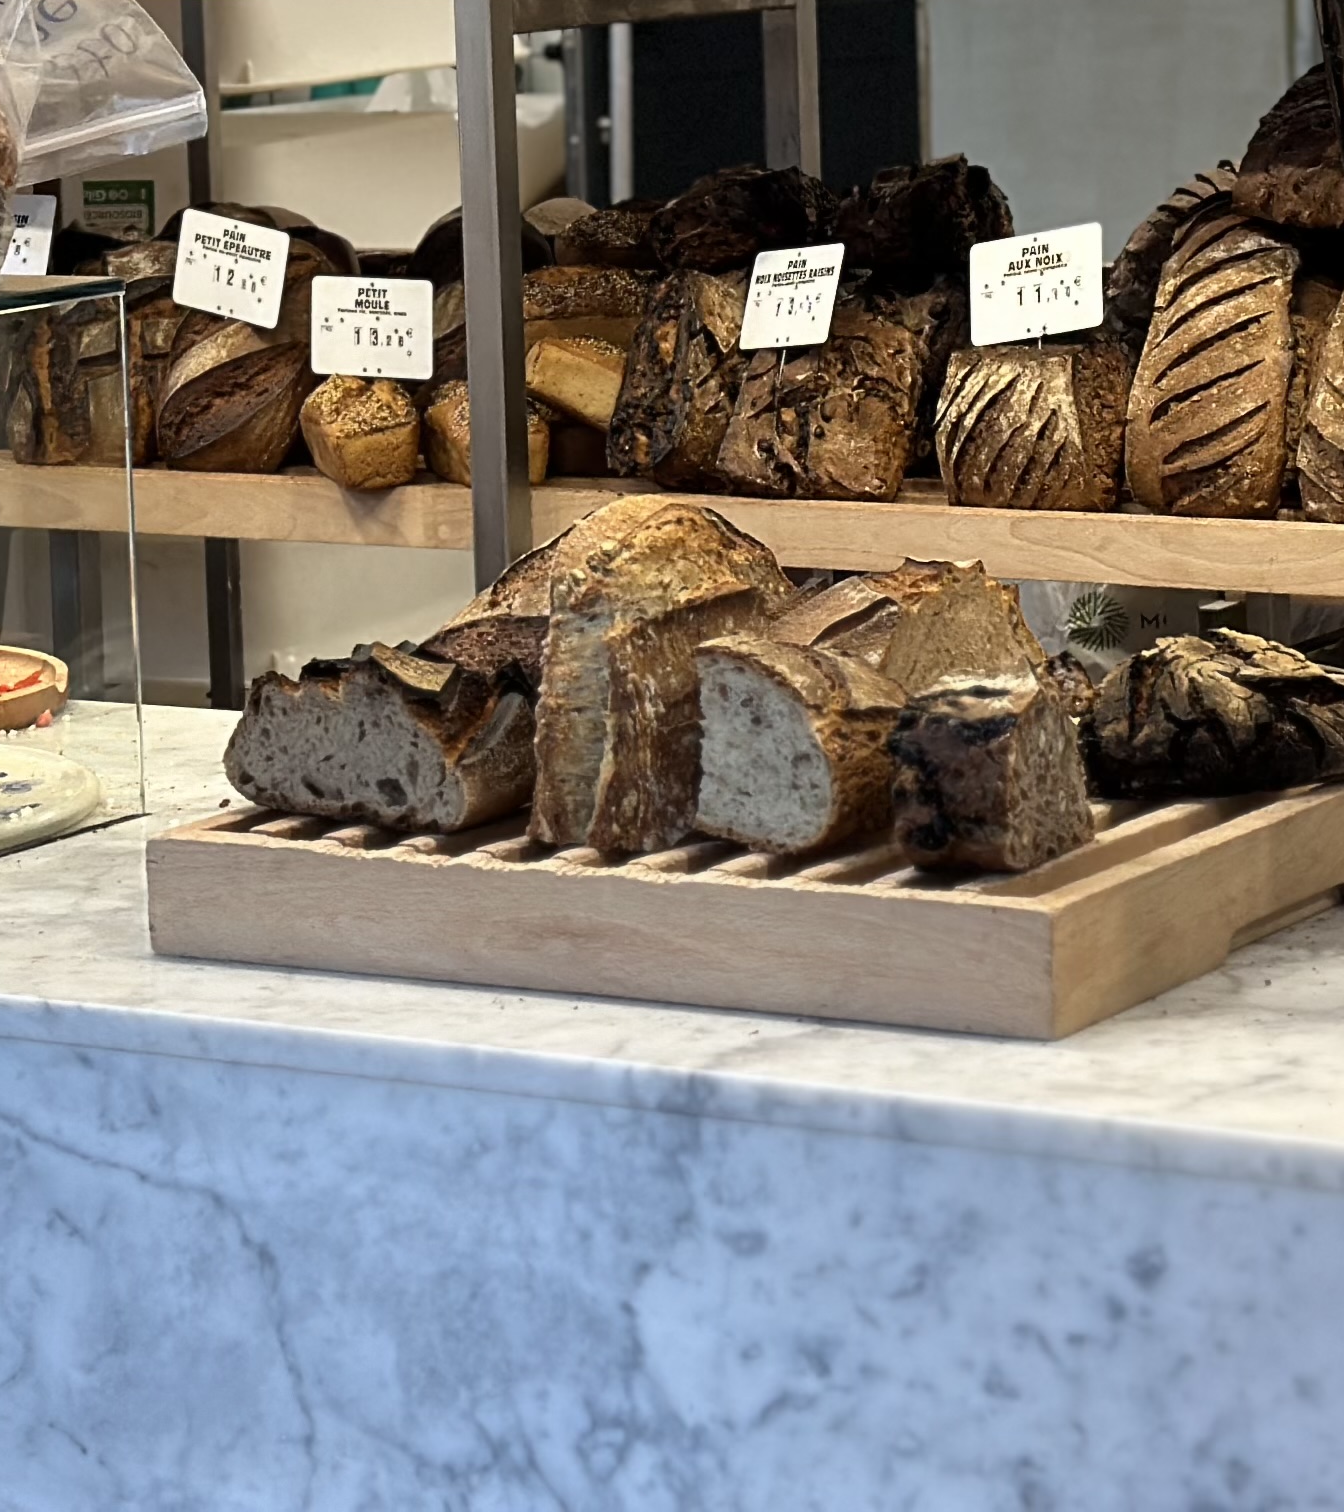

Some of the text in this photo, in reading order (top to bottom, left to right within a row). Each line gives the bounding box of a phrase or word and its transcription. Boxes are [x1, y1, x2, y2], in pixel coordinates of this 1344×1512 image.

[223, 229, 246, 243] PAIN
[195, 233, 221, 247] PETIT
[223, 240, 272, 261] EPEAUTRE
[1021, 243, 1049, 258] PAIN
[787, 259, 808, 269] PAIN
[1008, 259, 1031, 272] AUX
[1036, 252, 1063, 267] NOIX
[358, 288, 388, 298] PETIT
[354, 299, 390, 310] MOULE
